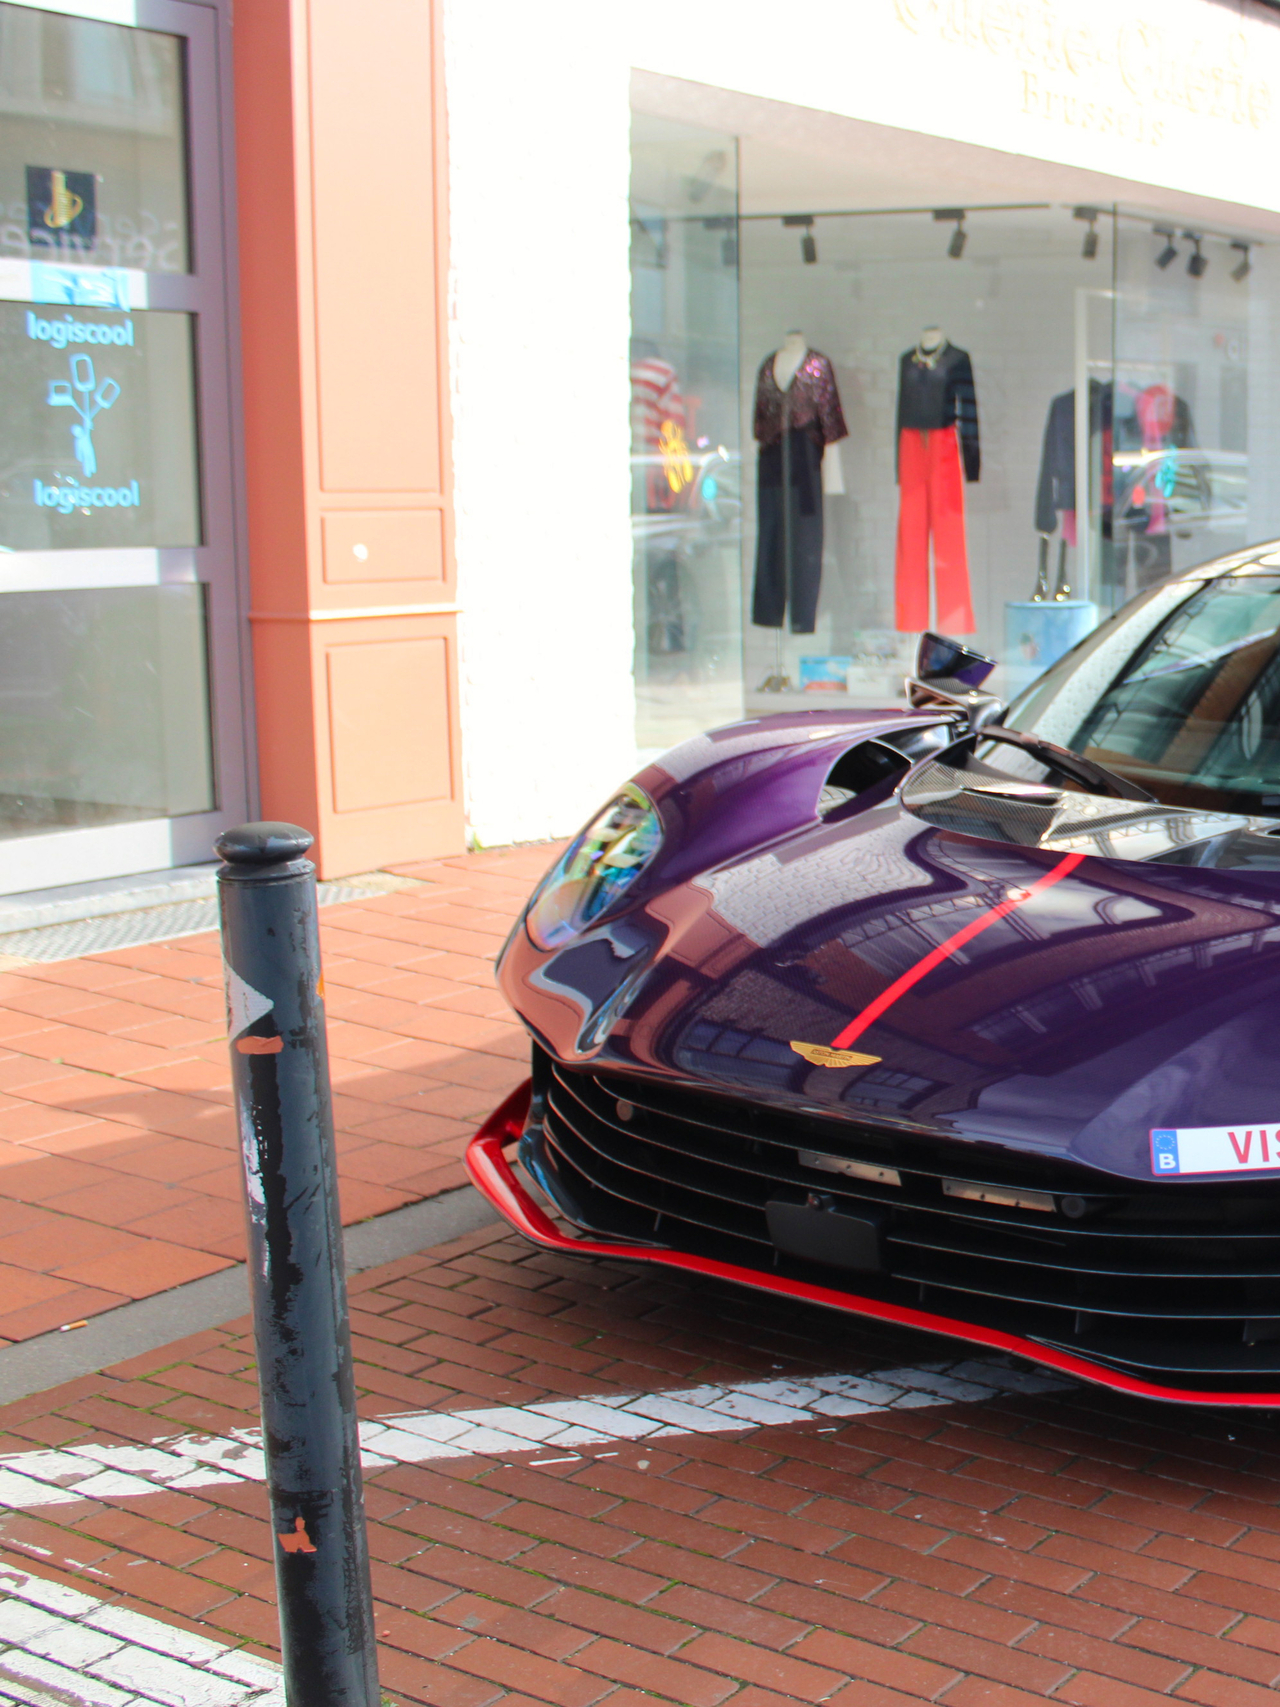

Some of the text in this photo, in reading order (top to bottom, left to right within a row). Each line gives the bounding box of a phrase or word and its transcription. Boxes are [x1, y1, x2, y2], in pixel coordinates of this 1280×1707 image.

[27, 310, 134, 348] logiscool
[34, 478, 140, 514] logiscool
[1159, 1153, 1176, 1169] B
